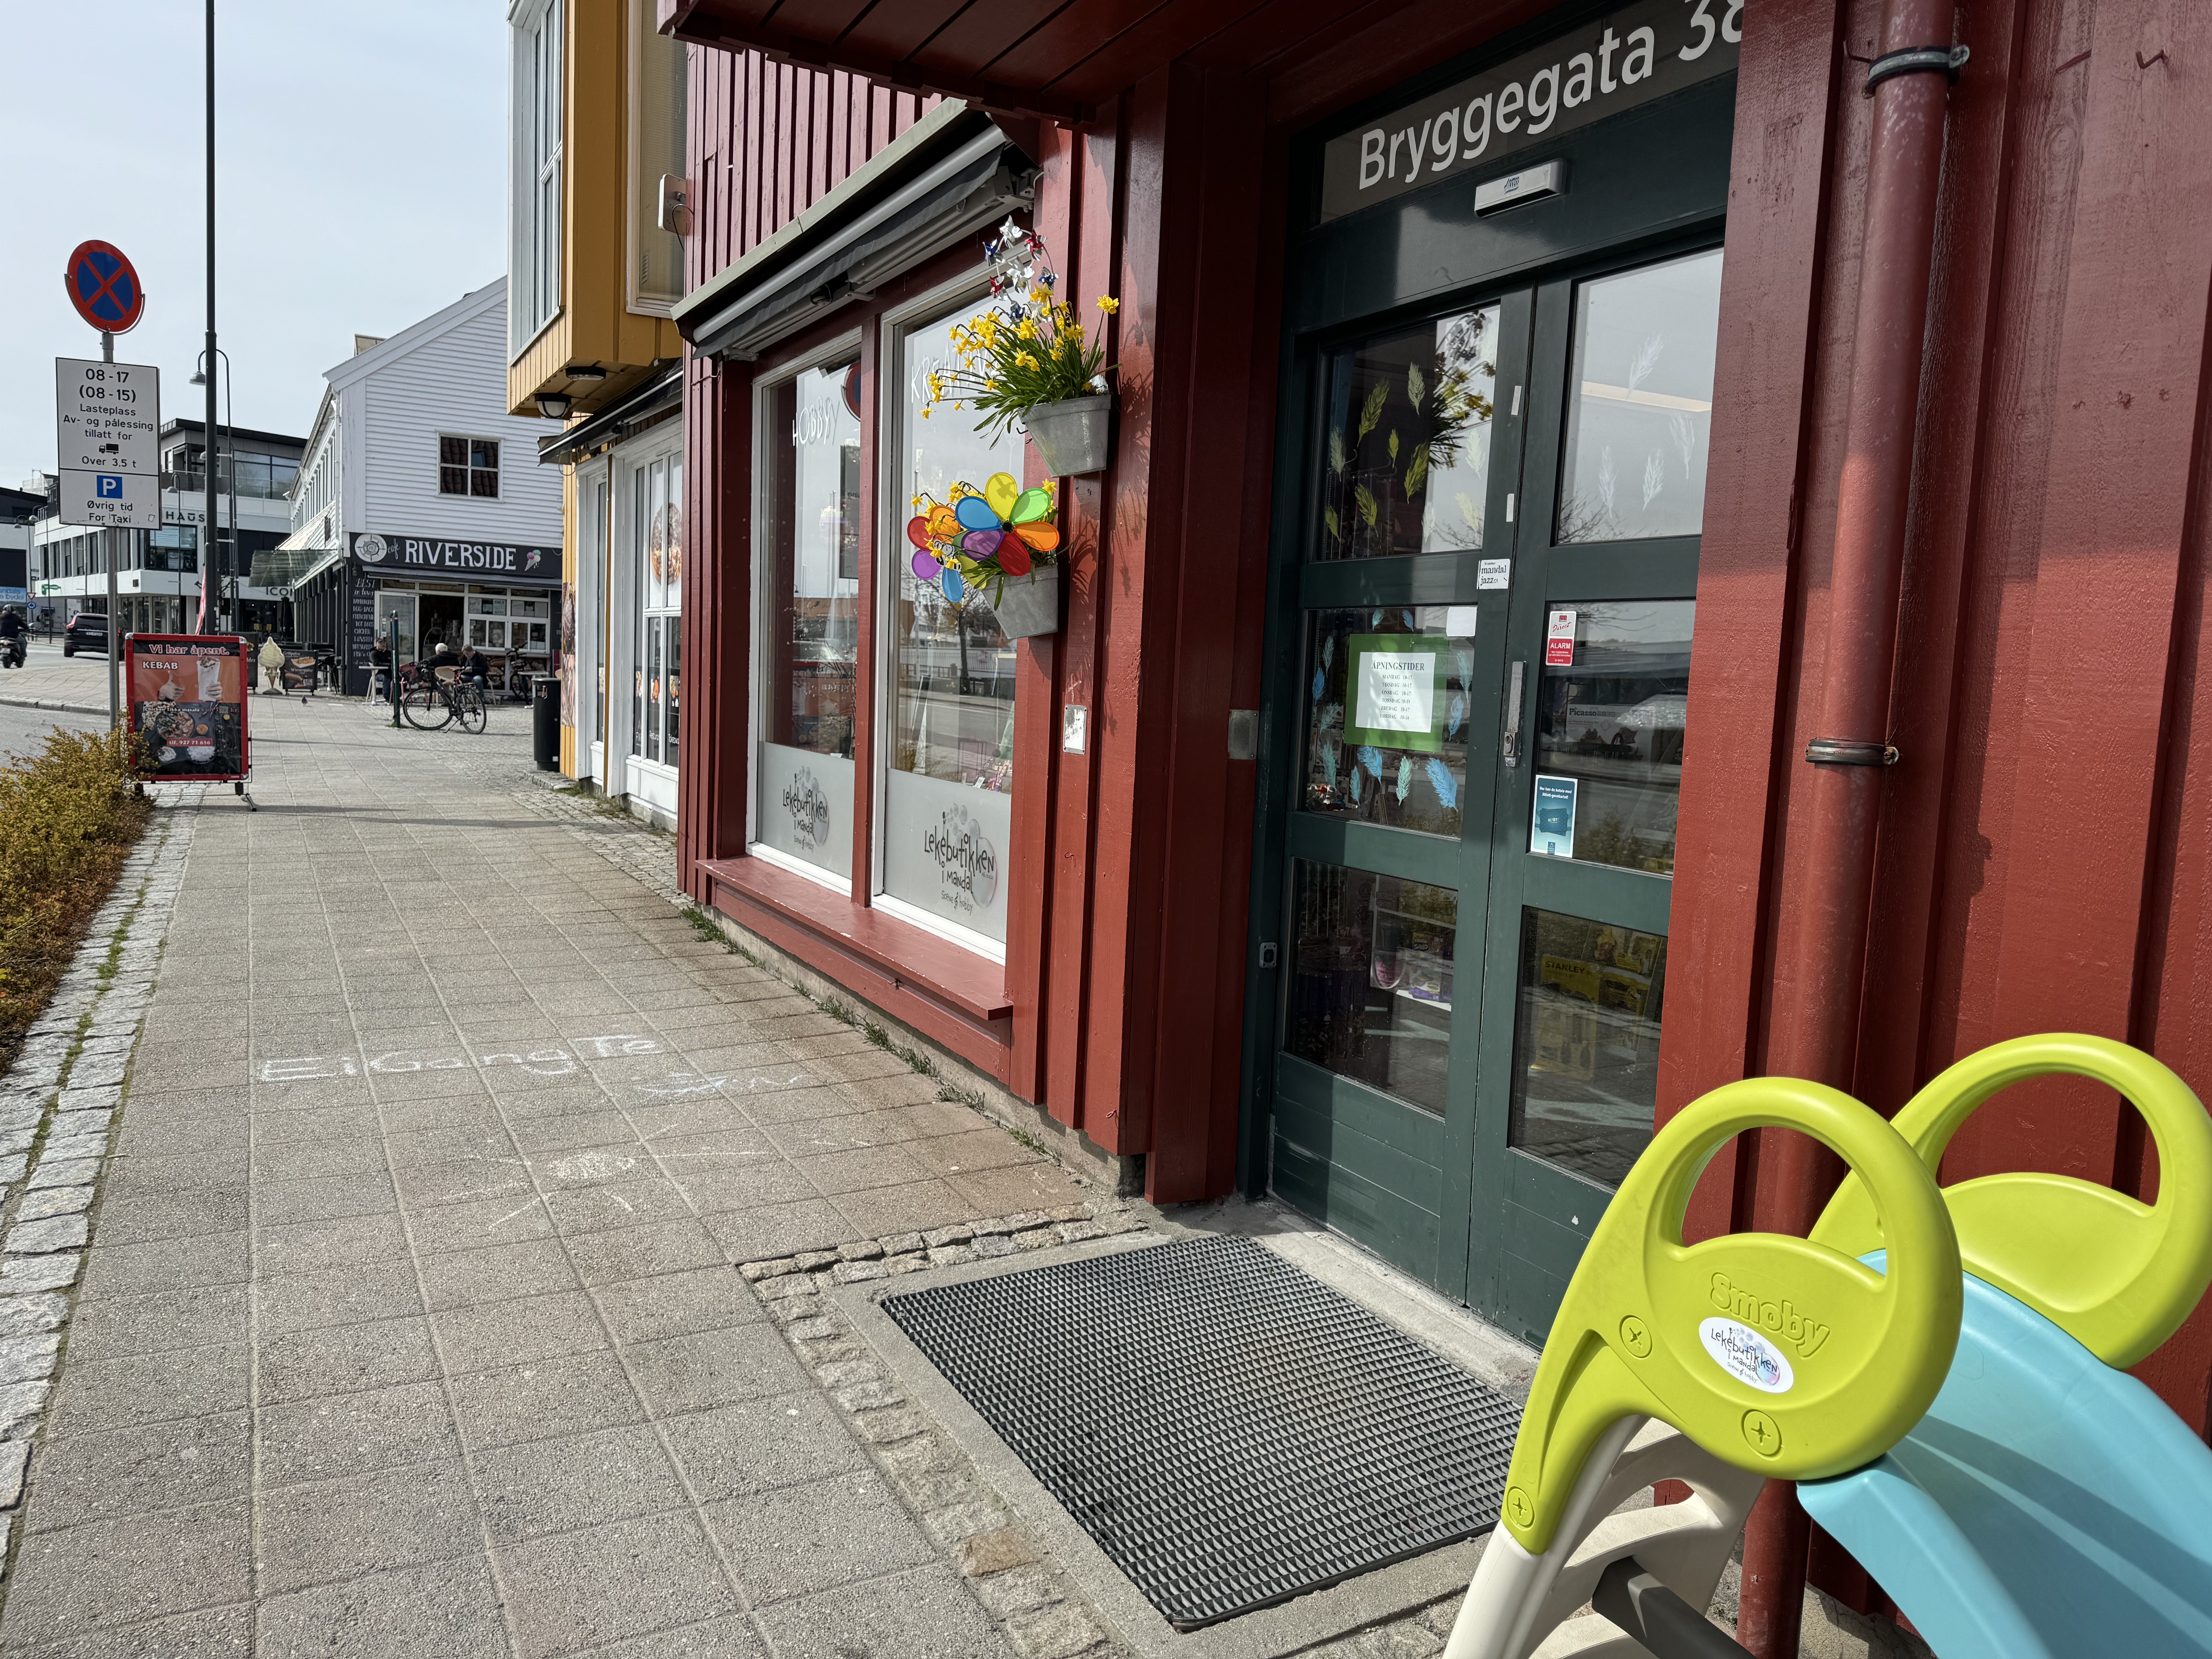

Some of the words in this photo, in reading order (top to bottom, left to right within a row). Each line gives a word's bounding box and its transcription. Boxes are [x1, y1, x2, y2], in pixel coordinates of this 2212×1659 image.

[1359, 26, 1655, 190] Bryggegata
[80, 404, 136, 416] Lasteplass
[64, 415, 80, 423] Av-
[87, 418, 99, 427] og
[105, 419, 153, 432] pålessing
[793, 396, 831, 448] HOBBY
[85, 429, 112, 439] tillatt
[118, 431, 132, 440] for
[82, 456, 106, 465] Over
[103, 479, 116, 495] P
[87, 500, 114, 512] Øvrig
[121, 503, 133, 511] tid
[89, 513, 106, 522] For
[111, 514, 131, 524] Taxi
[404, 539, 516, 570] RIVERSIDE
[1481, 565, 1506, 574] mandal
[1480, 576, 1494, 586] jazz
[149, 644, 163, 654] Vi
[166, 644, 188, 654] har
[190, 644, 230, 657] åpent.
[143, 661, 178, 670] KEBAB
[1371, 660, 1425, 671] ÅPNINGSTIDER
[1569, 708, 1596, 716] Picasso
[960, 895, 973, 916] hobby
[1545, 961, 1585, 974] STANLEY
[1711, 1272, 1832, 1360] Smoby
